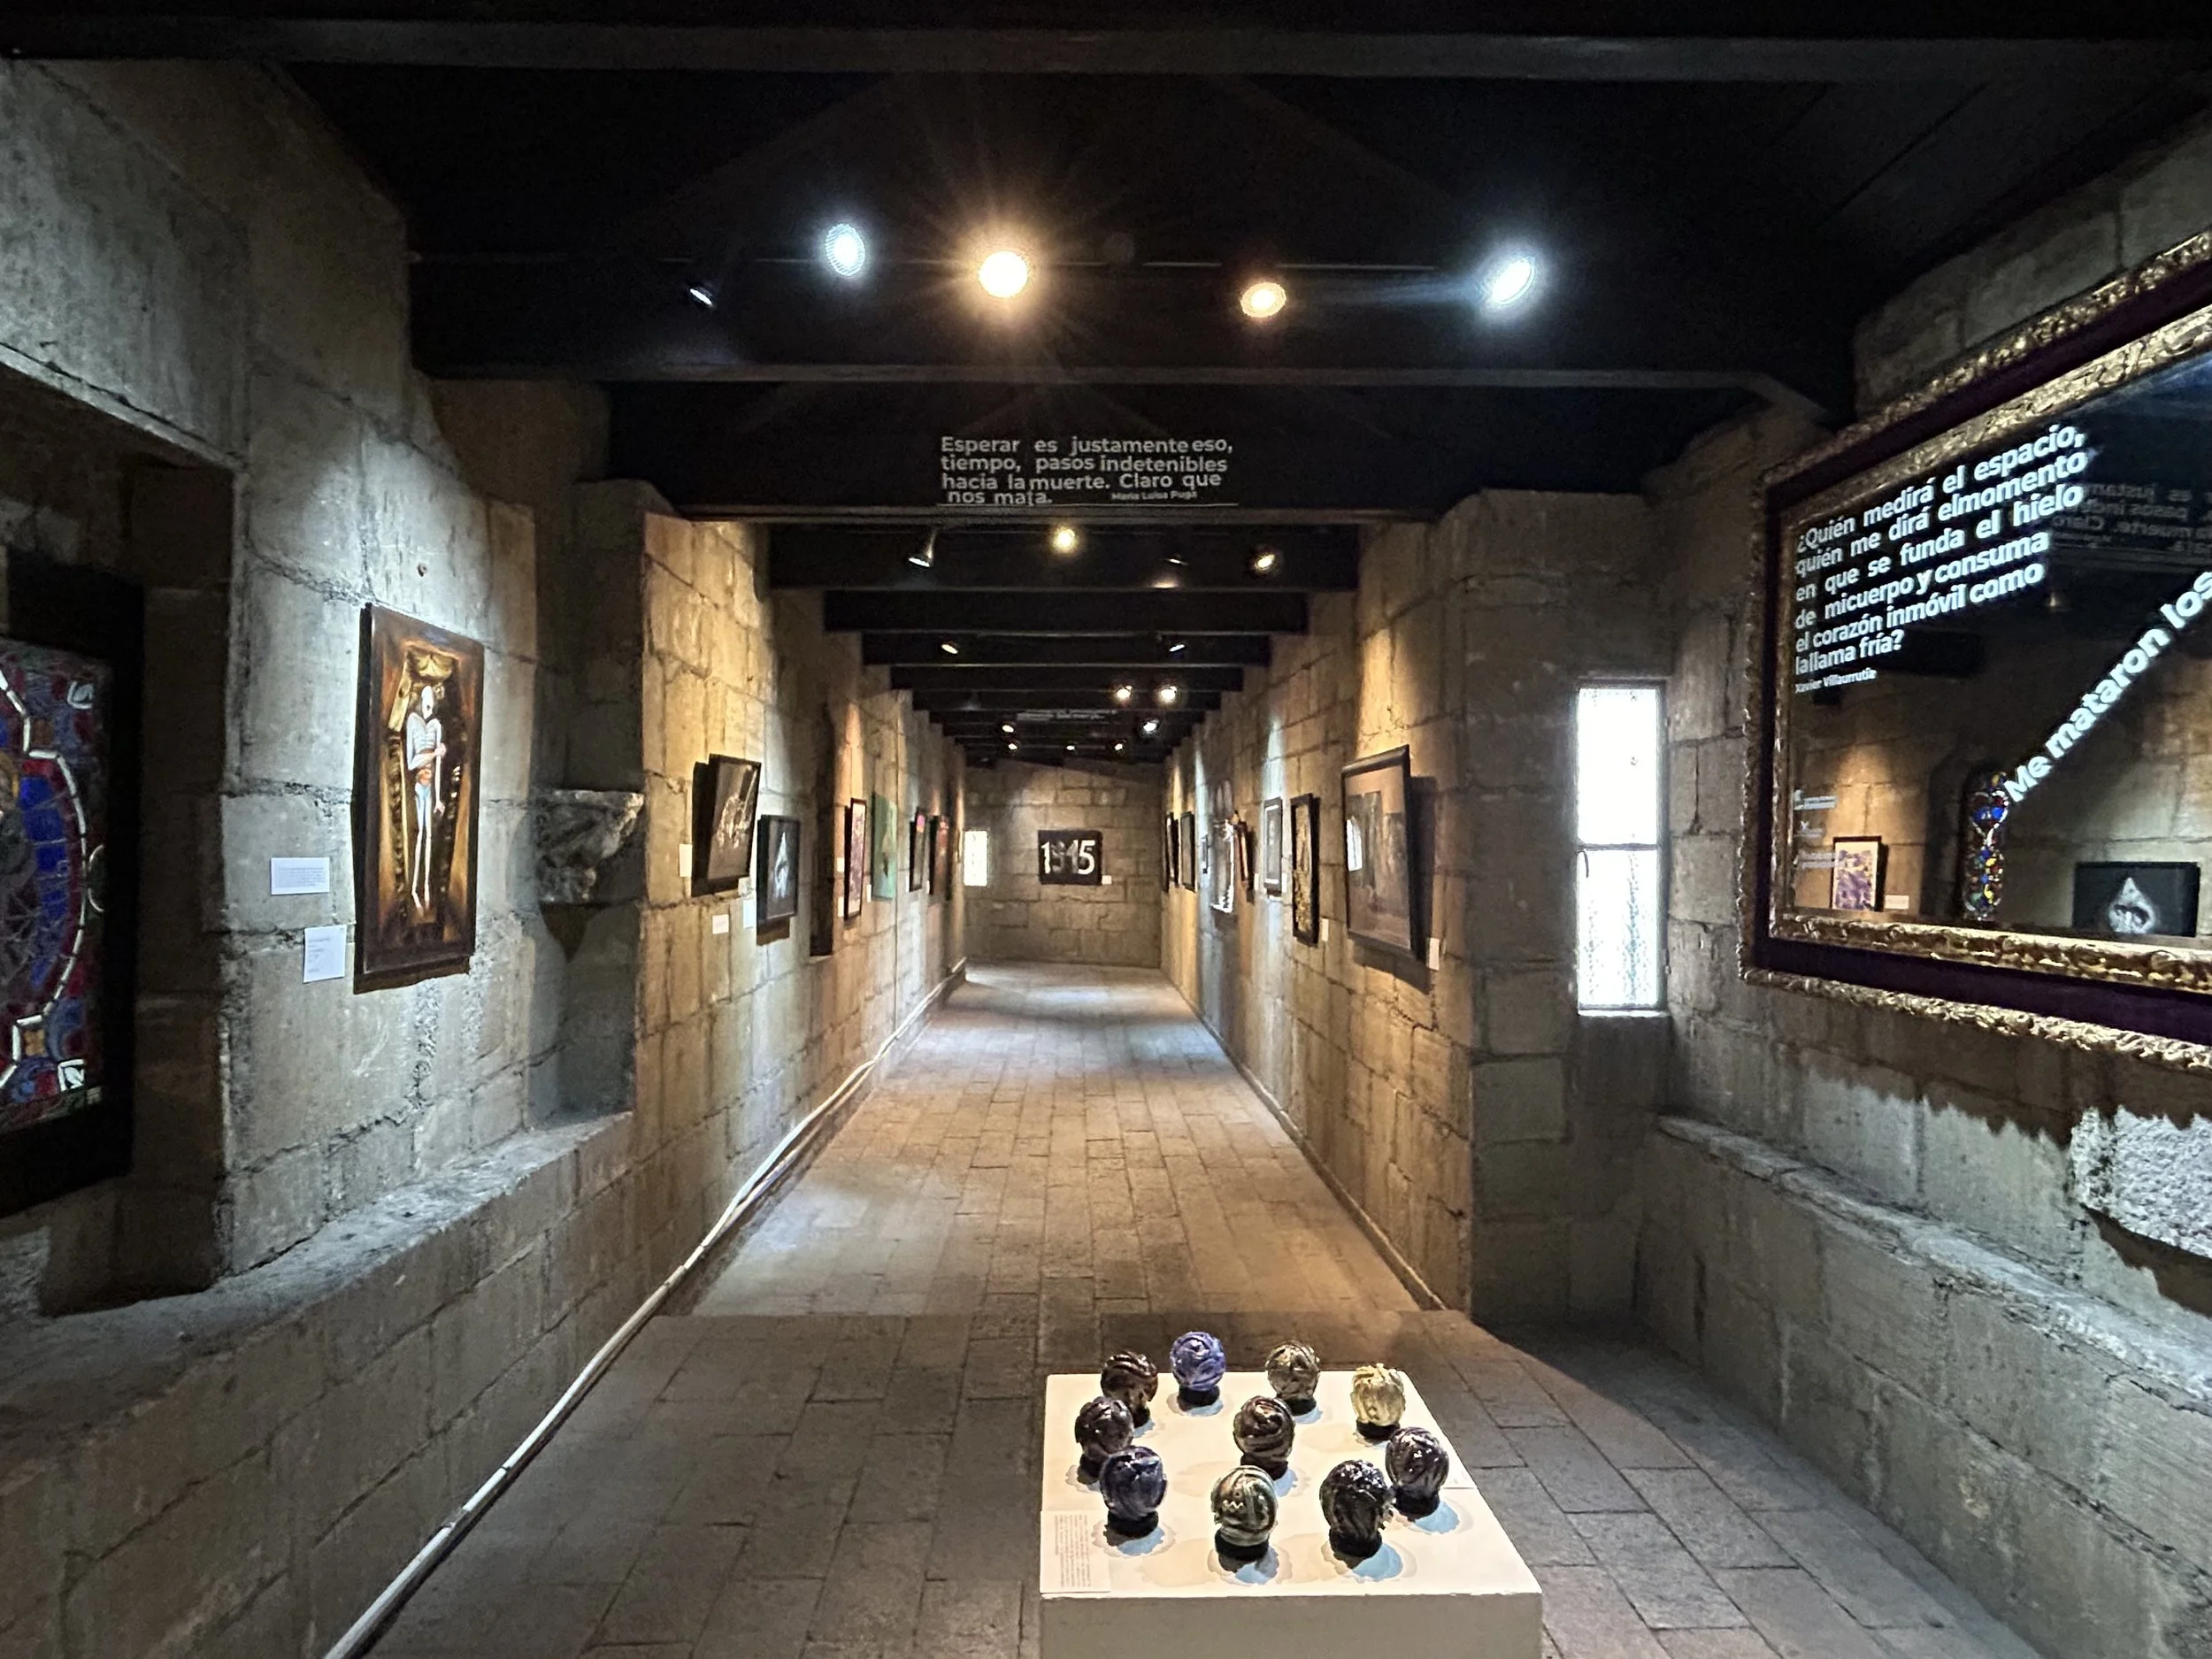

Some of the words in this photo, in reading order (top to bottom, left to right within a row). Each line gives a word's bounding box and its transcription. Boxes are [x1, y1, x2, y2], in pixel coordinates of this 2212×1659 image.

[940, 454, 1021, 474] tiempo,
[1035, 457, 1095, 474] pasos
[1100, 455, 1228, 472] indetenibles
[941, 436, 1020, 456] Esperar
[1034, 440, 1058, 453] es
[1069, 435, 1188, 457] justamente
[1192, 439, 1233, 454] eso,
[941, 472, 999, 489] hacia
[1008, 473, 1025, 490] la
[1029, 474, 1111, 490] muerte.
[1119, 472, 1173, 488] Claro
[1182, 473, 1222, 490] que
[947, 489, 986, 503] nos
[994, 490, 1053, 506] mata.
[1797, 516, 1856, 553] ¿Quién
[1863, 477, 1936, 526] medirá
[1942, 465, 1966, 493] el
[1974, 424, 2085, 480] espacio,
[1795, 547, 1843, 578] quién
[1851, 532, 1882, 557] me
[1888, 505, 1932, 541] dirá
[1796, 583, 1817, 602] en
[1824, 568, 1860, 595] que
[1868, 557, 1892, 577] se
[1900, 528, 1965, 565] funda
[1976, 510, 2001, 538] el
[2013, 484, 2084, 526] hielo
[1795, 609, 1816, 629] de
[1916, 568, 1933, 595] y
[1934, 531, 2050, 583] consuma
[1795, 631, 1809, 652] el
[1813, 613, 1883, 648] corazón
[1886, 584, 1967, 628] inmóvil
[1970, 563, 2045, 603] como
[1859, 629, 1905, 658] fría?
[2003, 756, 2053, 803] Me
[2045, 628, 2170, 759] mataron
